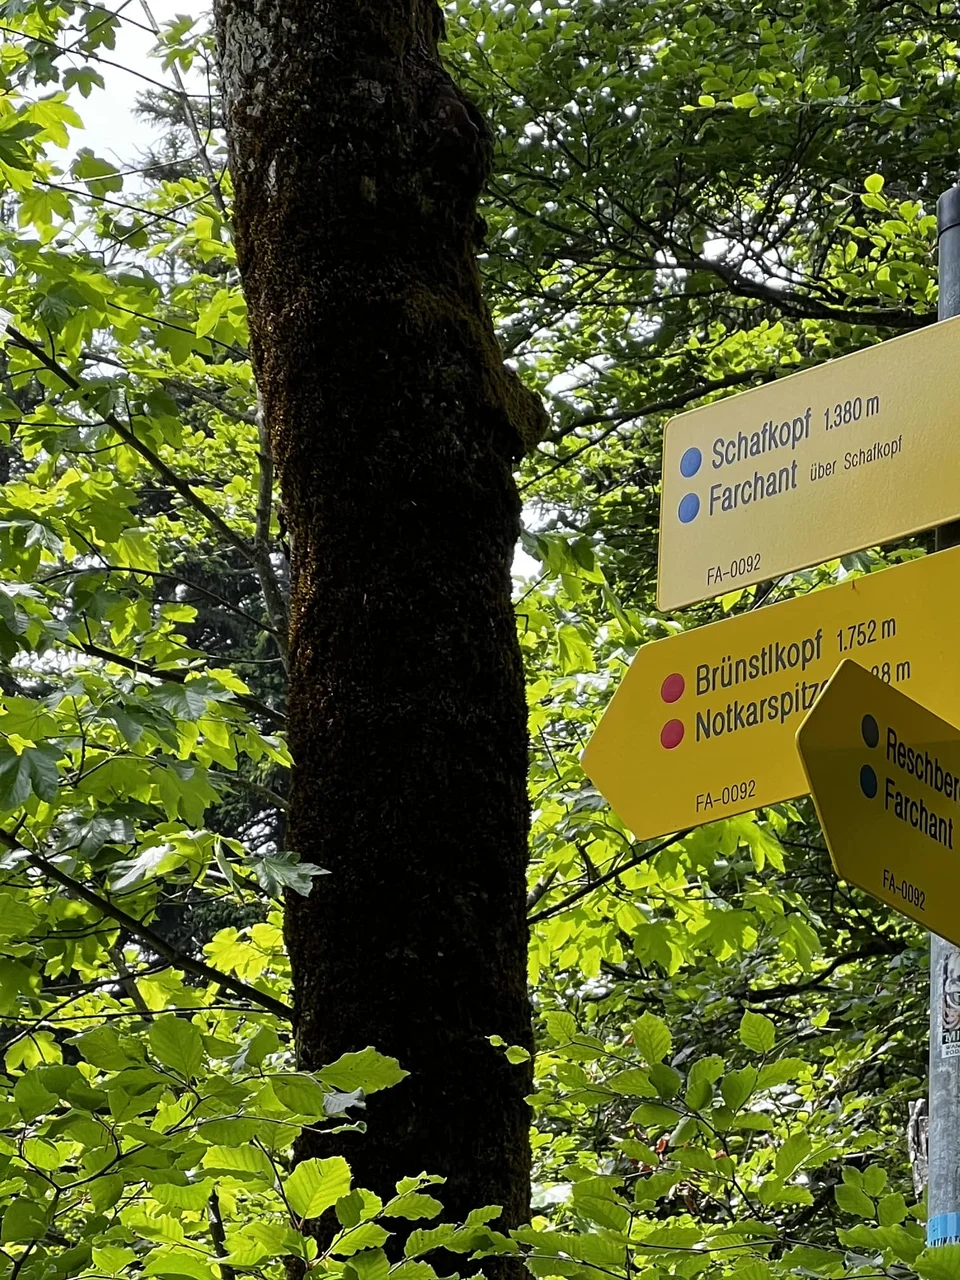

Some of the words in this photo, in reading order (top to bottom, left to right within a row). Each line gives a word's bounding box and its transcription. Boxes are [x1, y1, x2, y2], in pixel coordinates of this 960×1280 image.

[711, 406, 812, 469] Schafkopf
[824, 396, 862, 431] 1.380
[866, 395, 880, 417] m
[709, 459, 798, 516] Farchant
[810, 460, 837, 481] über
[844, 434, 903, 470] Schafkopf
[707, 553, 761, 586] FA-0092
[695, 628, 823, 697] Brünstlkopf
[836, 619, 877, 652] 1.752
[881, 617, 897, 640] m
[896, 660, 911, 683] m
[695, 779, 756, 813] FA-0092
[884, 777, 953, 850] Farchant
[882, 868, 926, 911] FA-0092
